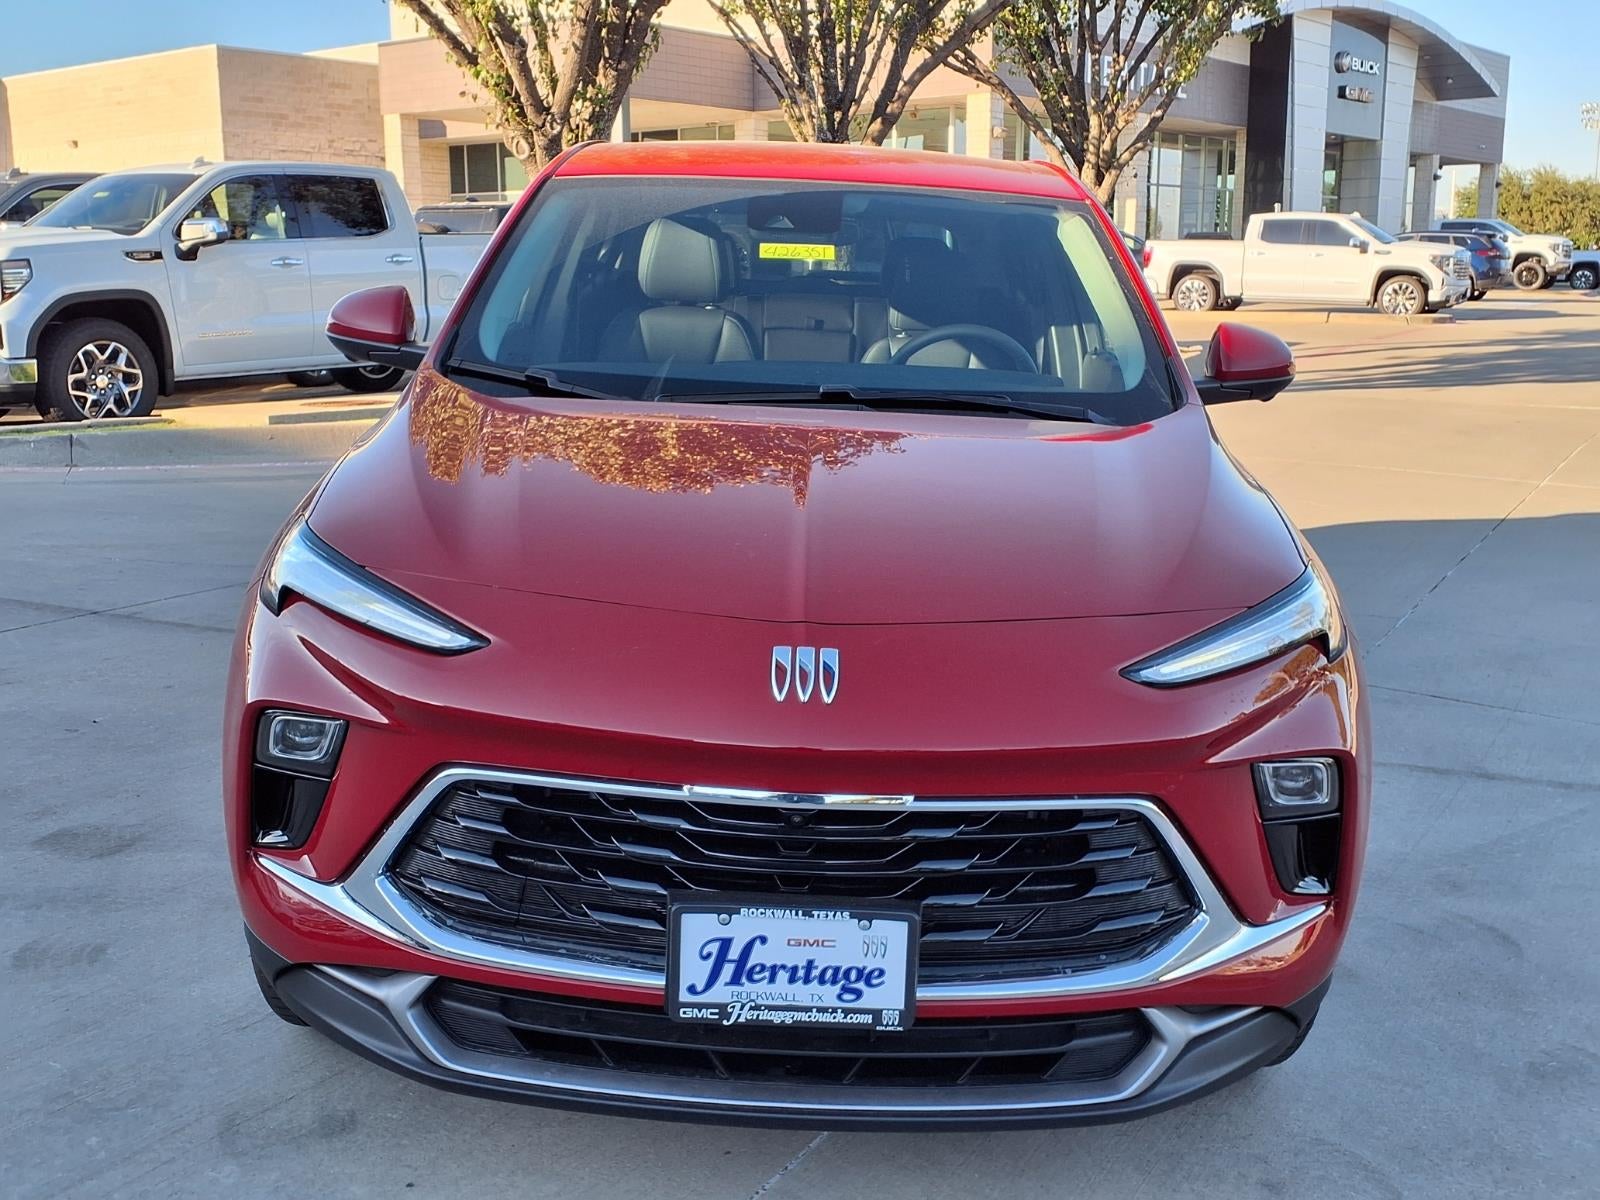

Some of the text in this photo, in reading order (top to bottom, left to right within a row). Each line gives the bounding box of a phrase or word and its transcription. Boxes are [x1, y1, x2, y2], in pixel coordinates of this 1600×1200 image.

[1351, 57, 1380, 75] BUICK
[763, 245, 827, 259] 426351
[812, 911, 851, 921] TEXAS
[786, 938, 837, 948] GMC
[686, 934, 886, 1003] Heritage
[809, 993, 825, 1003] TX
[679, 1000, 873, 1026] GMC Heritagegmcbuick.com
